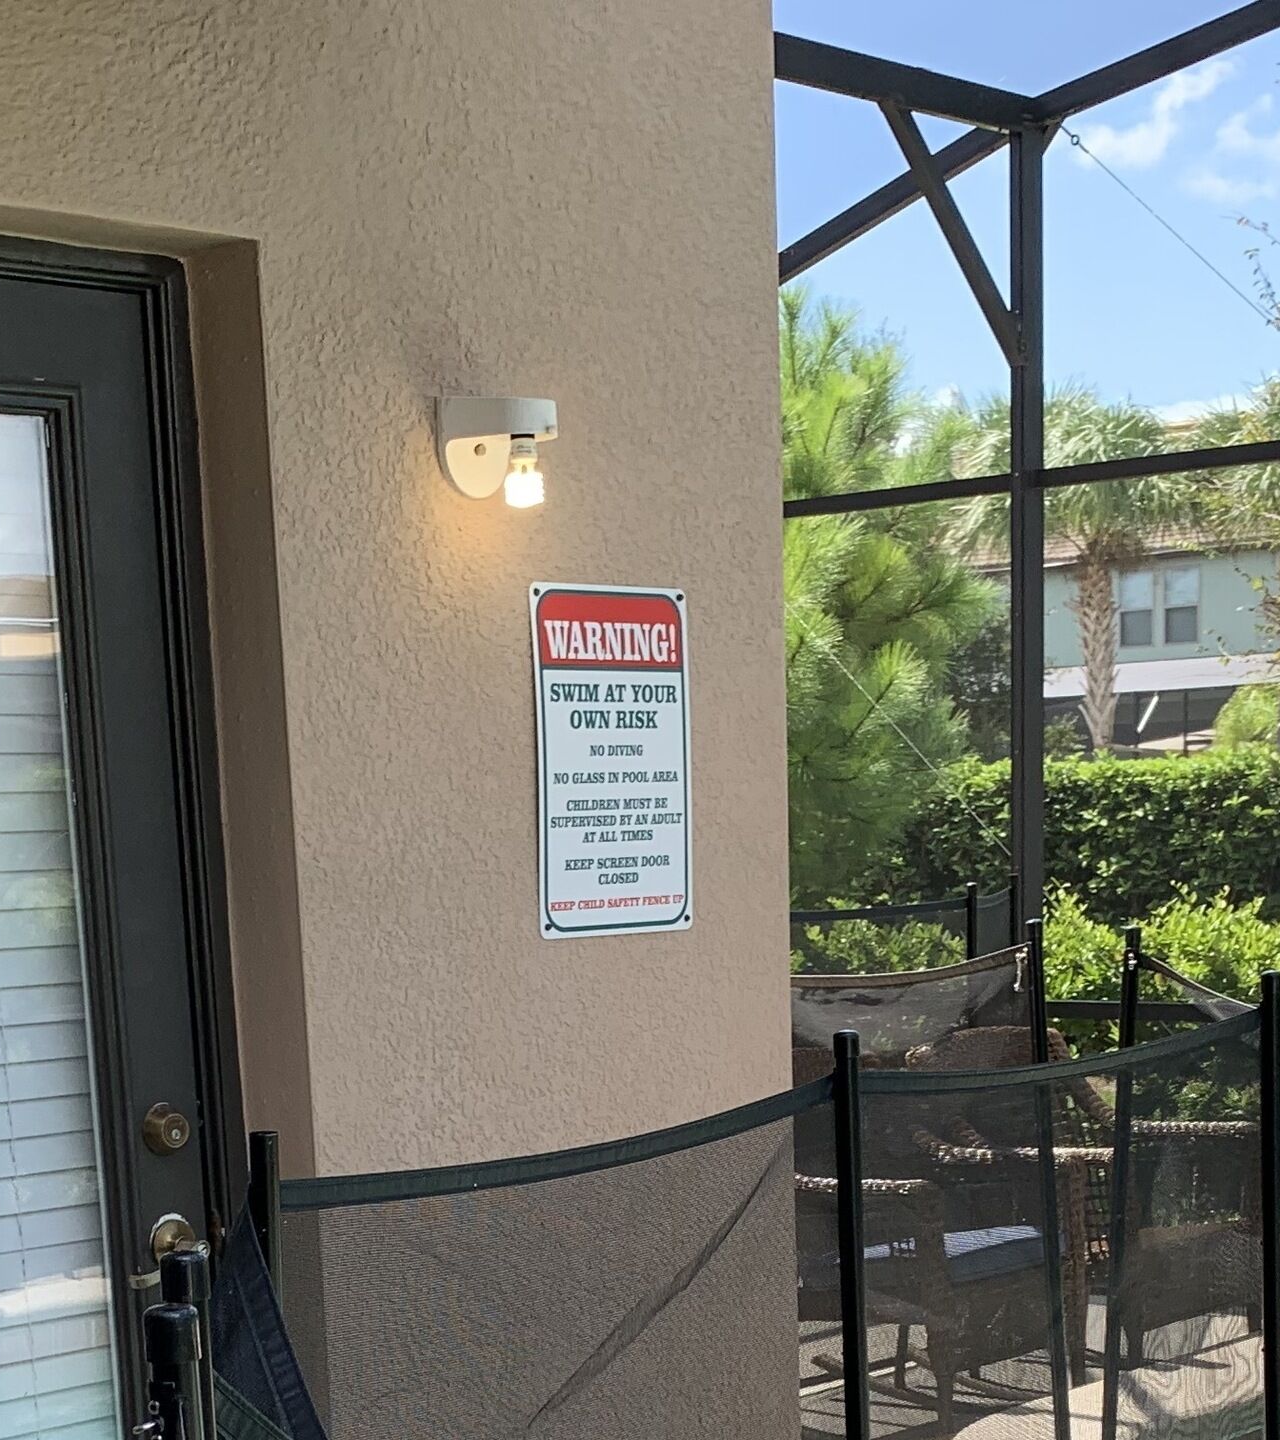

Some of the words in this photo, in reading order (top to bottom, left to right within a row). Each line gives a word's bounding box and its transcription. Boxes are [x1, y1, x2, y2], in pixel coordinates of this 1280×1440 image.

[544, 620, 676, 662] WARNING!
[550, 683, 599, 702] SWIM
[604, 685, 626, 702] AT
[631, 685, 677, 703] YOUR
[570, 710, 610, 729] OWN
[616, 711, 658, 728] RISK
[590, 745, 604, 756] NO
[608, 745, 643, 756] DIVING
[553, 773, 569, 784] NO
[573, 773, 605, 784] GLASS
[608, 772, 619, 783] IN
[622, 772, 649, 783] POOL
[652, 771, 678, 782] AREA
[567, 799, 620, 811] CHILDREN
[623, 798, 652, 809] MUST
[655, 798, 668, 808] BE
[551, 816, 617, 828] SUPERVISED
[619, 815, 632, 826] BY
[635, 814, 648, 825] AN
[651, 813, 682, 824] ADULT
[583, 832, 596, 843] AT
[599, 832, 617, 842] ALL
[621, 830, 653, 841] TIMES
[565, 859, 594, 870] KEEP
[597, 857, 638, 869] SCREEN
[641, 856, 669, 867] DOOR
[598, 873, 638, 885] CLOSED
[550, 901, 575, 911] KEEP
[578, 900, 605, 909] CHILD
[608, 898, 640, 908] SAFETY
[642, 896, 670, 905] FENCE
[673, 895, 684, 903] UP
